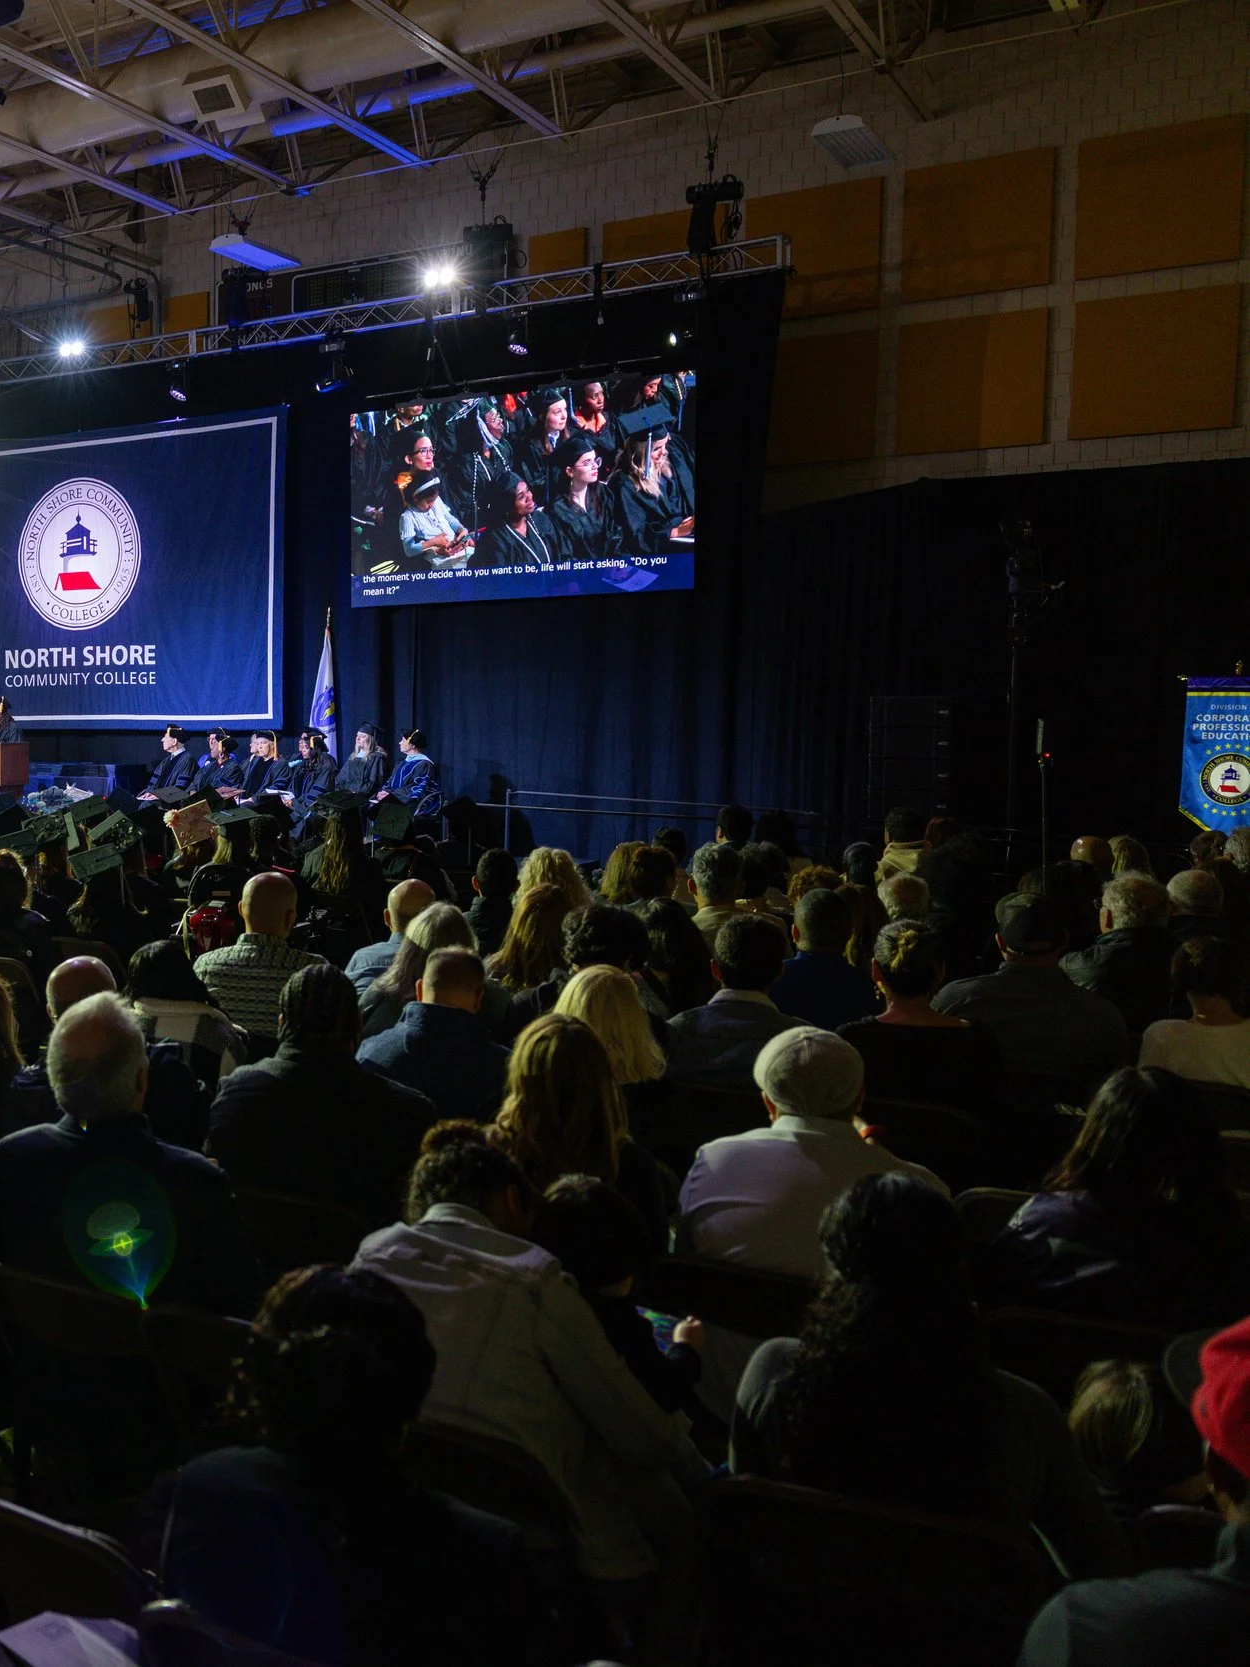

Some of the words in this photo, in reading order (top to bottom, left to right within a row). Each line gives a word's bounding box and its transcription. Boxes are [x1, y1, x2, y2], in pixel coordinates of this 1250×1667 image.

[26, 513, 46, 561] NORTH
[46, 488, 83, 513] SHORE
[86, 488, 134, 556] COMMUNITY
[363, 575, 375, 583] the
[378, 573, 409, 582] moment
[411, 573, 426, 581] you
[428, 569, 453, 579] decide
[455, 569, 472, 577] who
[474, 568, 489, 577] you
[492, 566, 512, 574] want
[513, 565, 523, 573] to
[525, 564, 538, 573] be,
[541, 563, 554, 571] life
[557, 562, 570, 570] will
[573, 561, 594, 569] start
[596, 558, 628, 569] asking,
[650, 556, 667, 566] you
[113, 568, 130, 594] 1965
[363, 588, 384, 596] mean
[51, 602, 106, 621] COLLEGE
[5, 647, 76, 669] NORTH
[82, 645, 156, 666] SHORE
[5, 672, 90, 687] COMMUNITY
[94, 671, 156, 685] COLLEGE
[1196, 714, 1250, 722] CORPORA
[1201, 732, 1250, 740] EDUCATI
